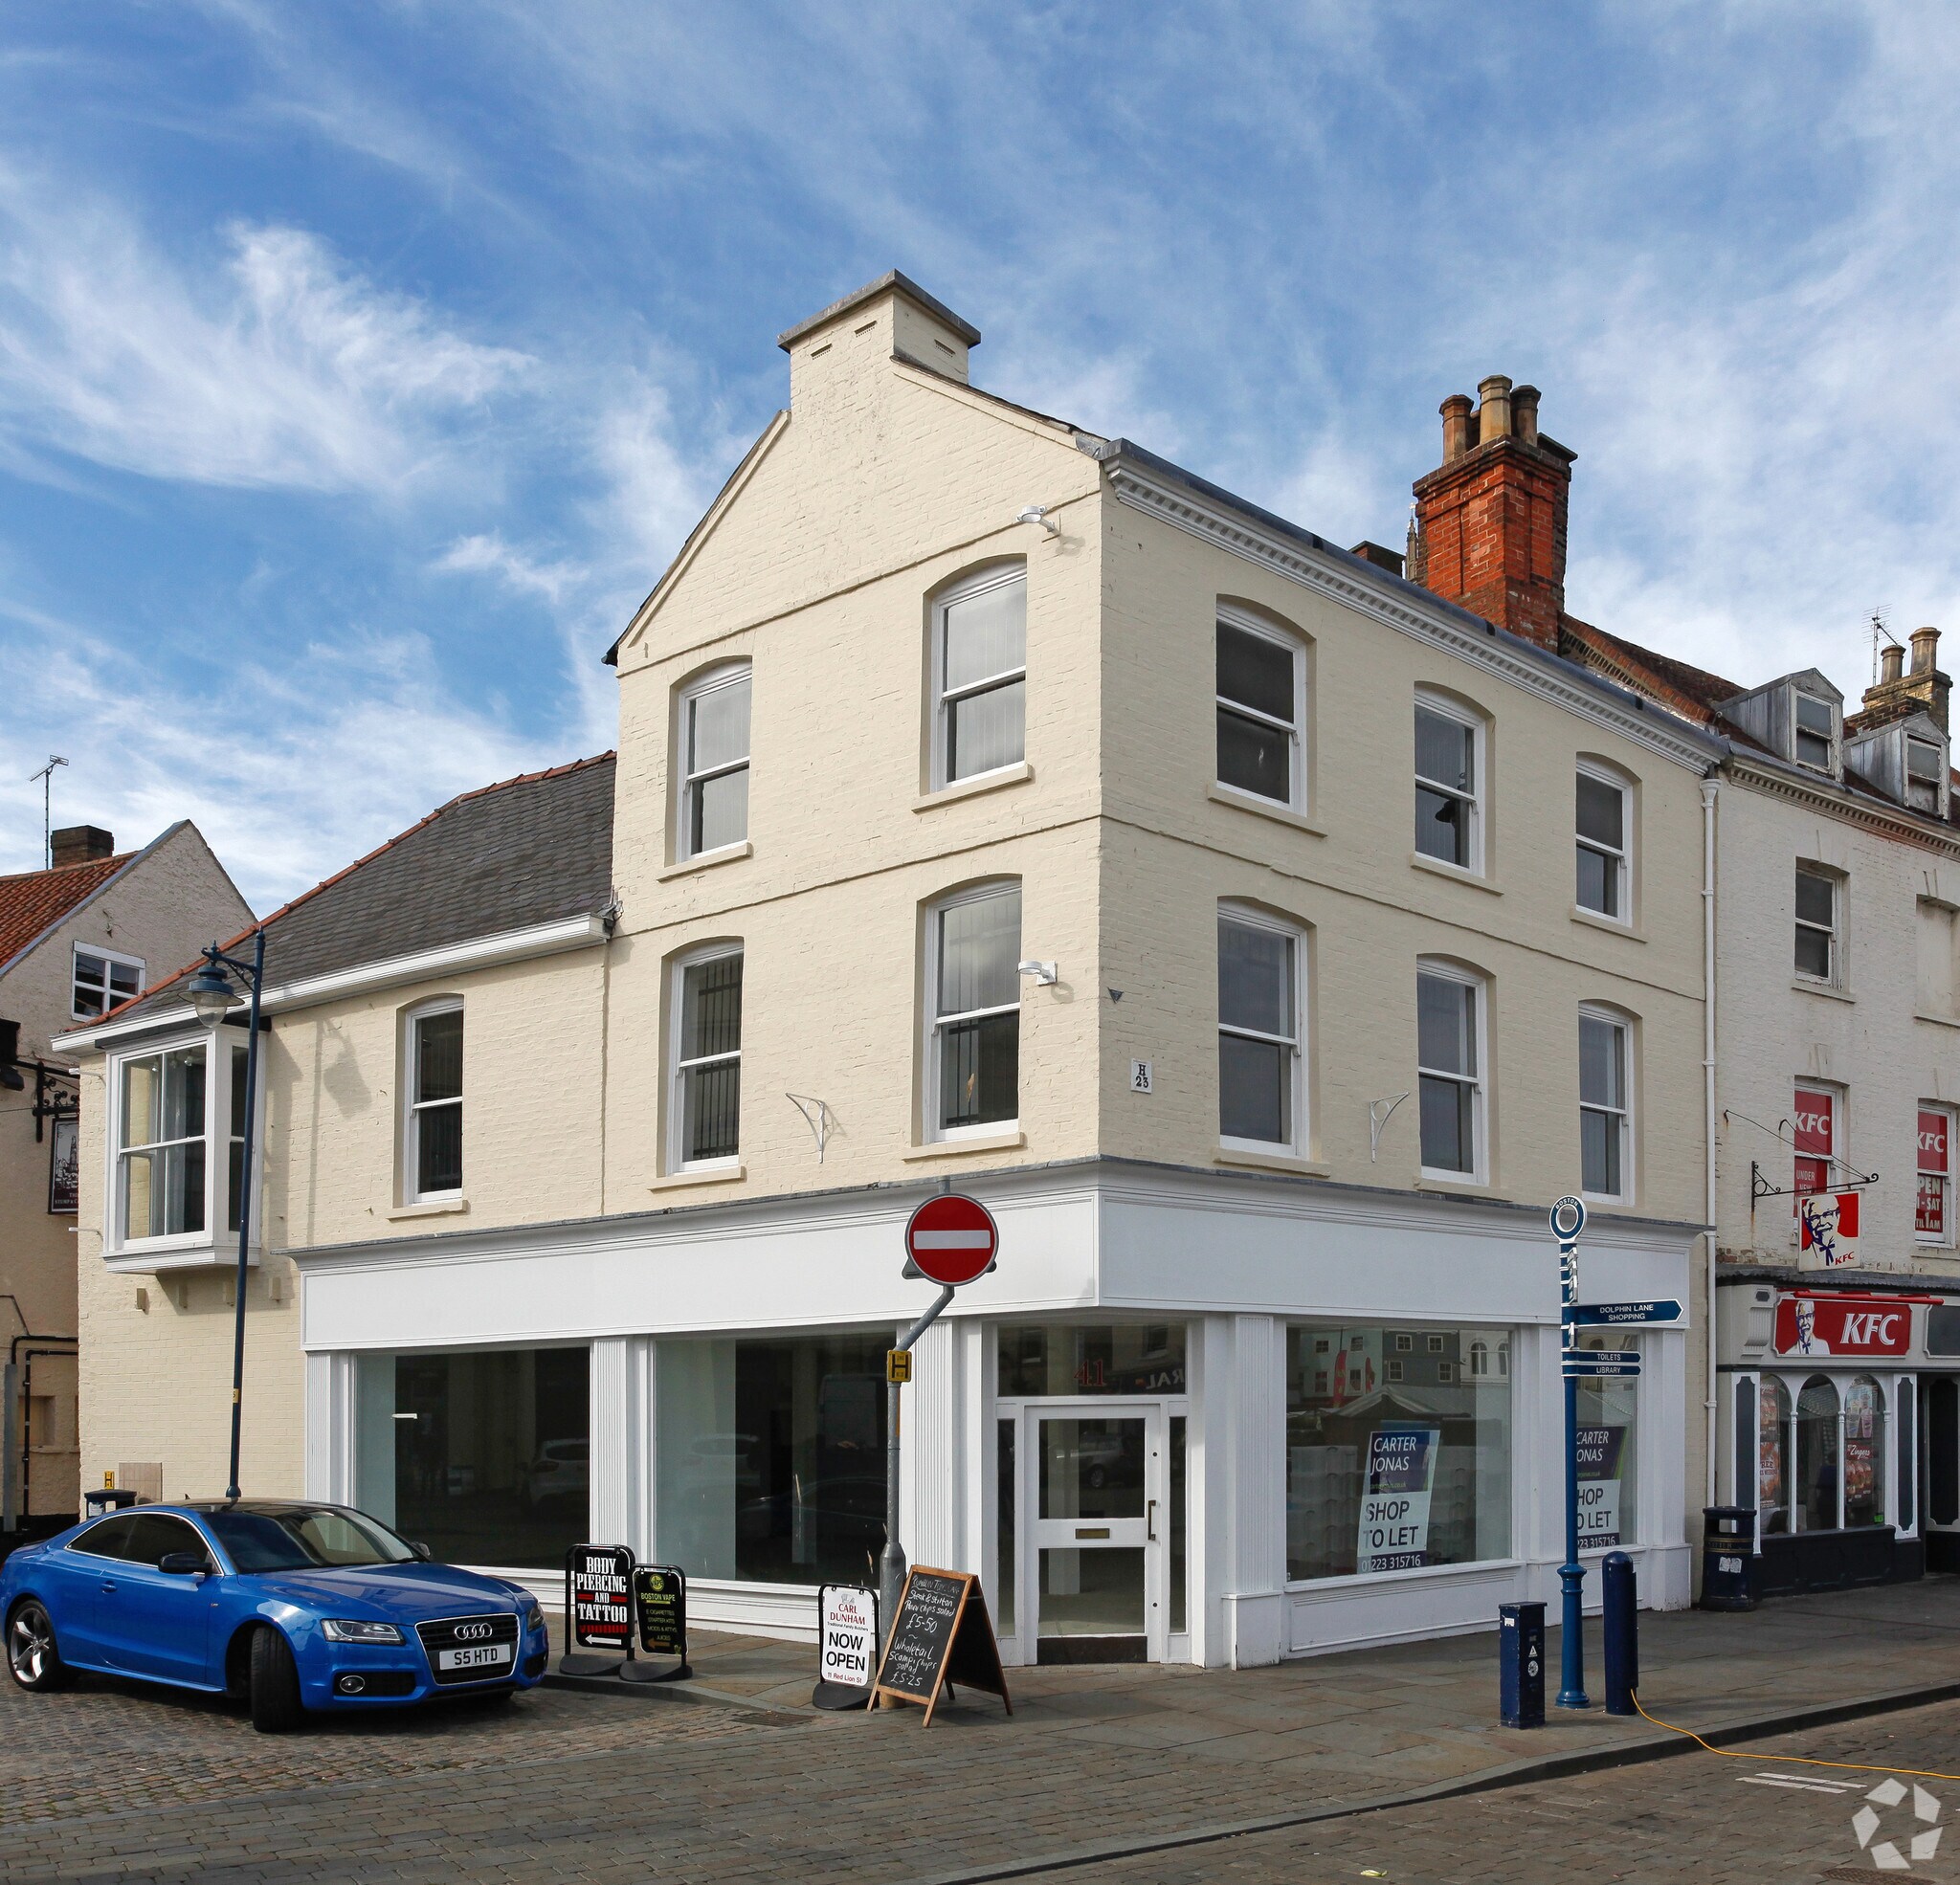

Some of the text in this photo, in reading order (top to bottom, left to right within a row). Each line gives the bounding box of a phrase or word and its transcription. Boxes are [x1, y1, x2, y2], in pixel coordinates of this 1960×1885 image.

[1138, 1064, 1147, 1076] H
[1135, 1076, 1148, 1088] 23
[1794, 1111, 1830, 1136] KFC
[1918, 1132, 1945, 1153] KFC
[1795, 1169, 1815, 1182] UNDER
[1918, 1177, 1941, 1195] PEN
[1555, 1197, 1579, 1209] BOSTON
[1927, 1198, 1941, 1211] SAT
[1835, 1251, 1855, 1266] KFC
[1599, 1303, 1654, 1314] DOLPHIN LANE
[1608, 1312, 1645, 1321] SHOPPING
[1839, 1313, 1899, 1345] KFC
[1596, 1353, 1621, 1362] TOILETS
[892, 1354, 908, 1378] H
[1074, 1359, 1106, 1386] 41
[1373, 1436, 1417, 1453] CARTER
[1576, 1430, 1610, 1445] CARTER
[1576, 1448, 1603, 1463] ONAS
[1370, 1456, 1410, 1475] JONAS
[104, 1472, 113, 1488] H
[1577, 1488, 1604, 1506] HOP
[1365, 1500, 1410, 1522] SHOP
[1588, 1511, 1612, 1529] LET
[1363, 1525, 1418, 1549] TO LET
[1590, 1536, 1616, 1549] 315716
[586, 1556, 616, 1575] BODY
[1389, 1555, 1421, 1570] 315716
[576, 1573, 627, 1593] PIERCING
[593, 1592, 611, 1604] AND
[640, 1592, 676, 1602] BOSTON VAPE
[577, 1603, 628, 1623] TATTOO
[838, 1603, 858, 1614] CARL
[830, 1612, 866, 1626] DUNHAM
[829, 1631, 863, 1652] NOW
[454, 1648, 498, 1666] S5 HTD
[826, 1651, 865, 1672] OPEN
[844, 1674, 856, 1682] Lion
